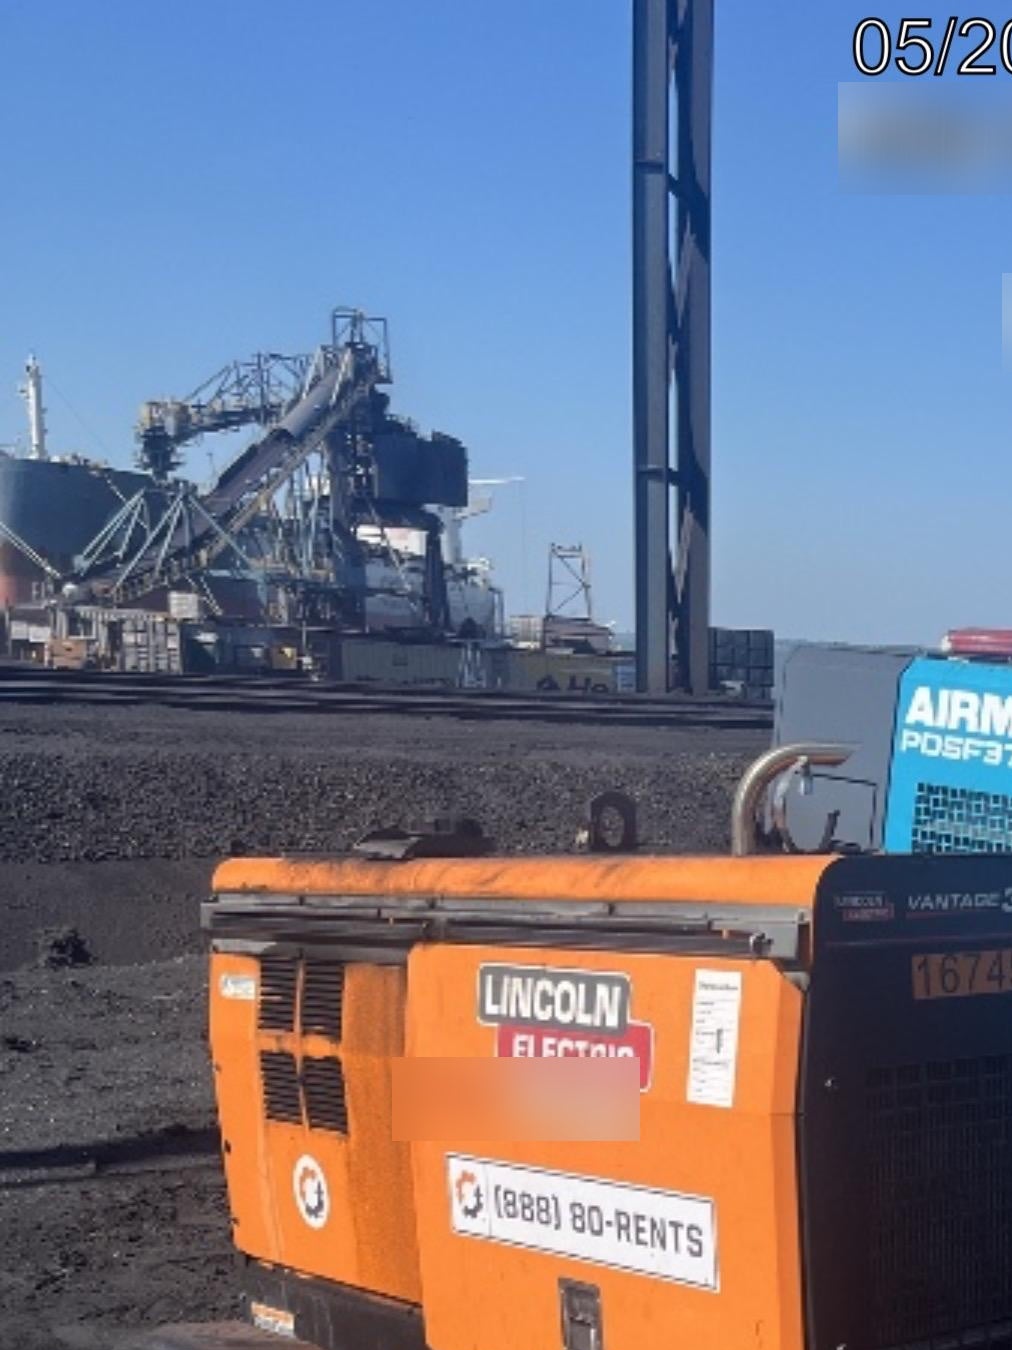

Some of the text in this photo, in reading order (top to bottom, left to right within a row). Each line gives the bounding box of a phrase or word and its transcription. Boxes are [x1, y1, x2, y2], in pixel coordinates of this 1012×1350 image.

[908, 893, 1000, 911] VANTAGE
[484, 974, 621, 1027] LINCOLN
[494, 1184, 704, 1258] (888) 80-RENTS
